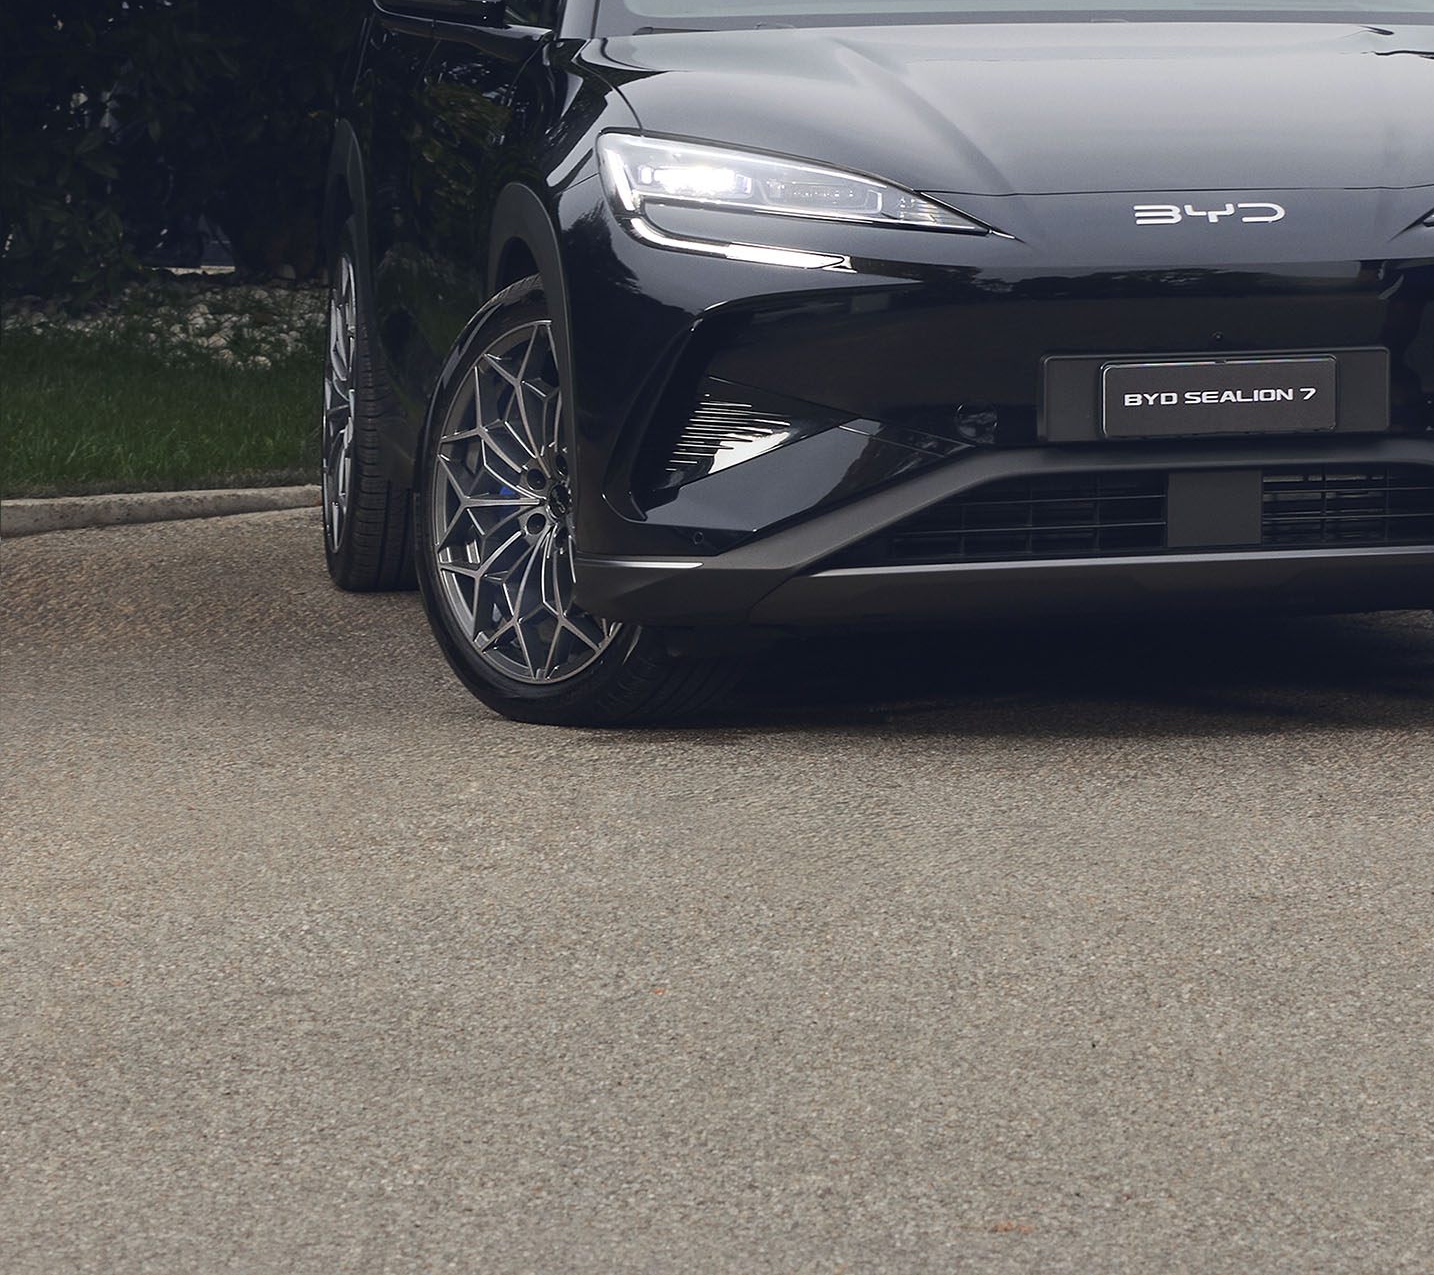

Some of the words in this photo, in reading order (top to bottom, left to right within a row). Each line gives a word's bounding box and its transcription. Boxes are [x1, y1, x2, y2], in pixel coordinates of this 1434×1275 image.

[1134, 203, 1286, 224] BYD
[1125, 392, 1177, 406] BYD
[1184, 389, 1293, 404] SEALION
[1300, 388, 1317, 399] 7
